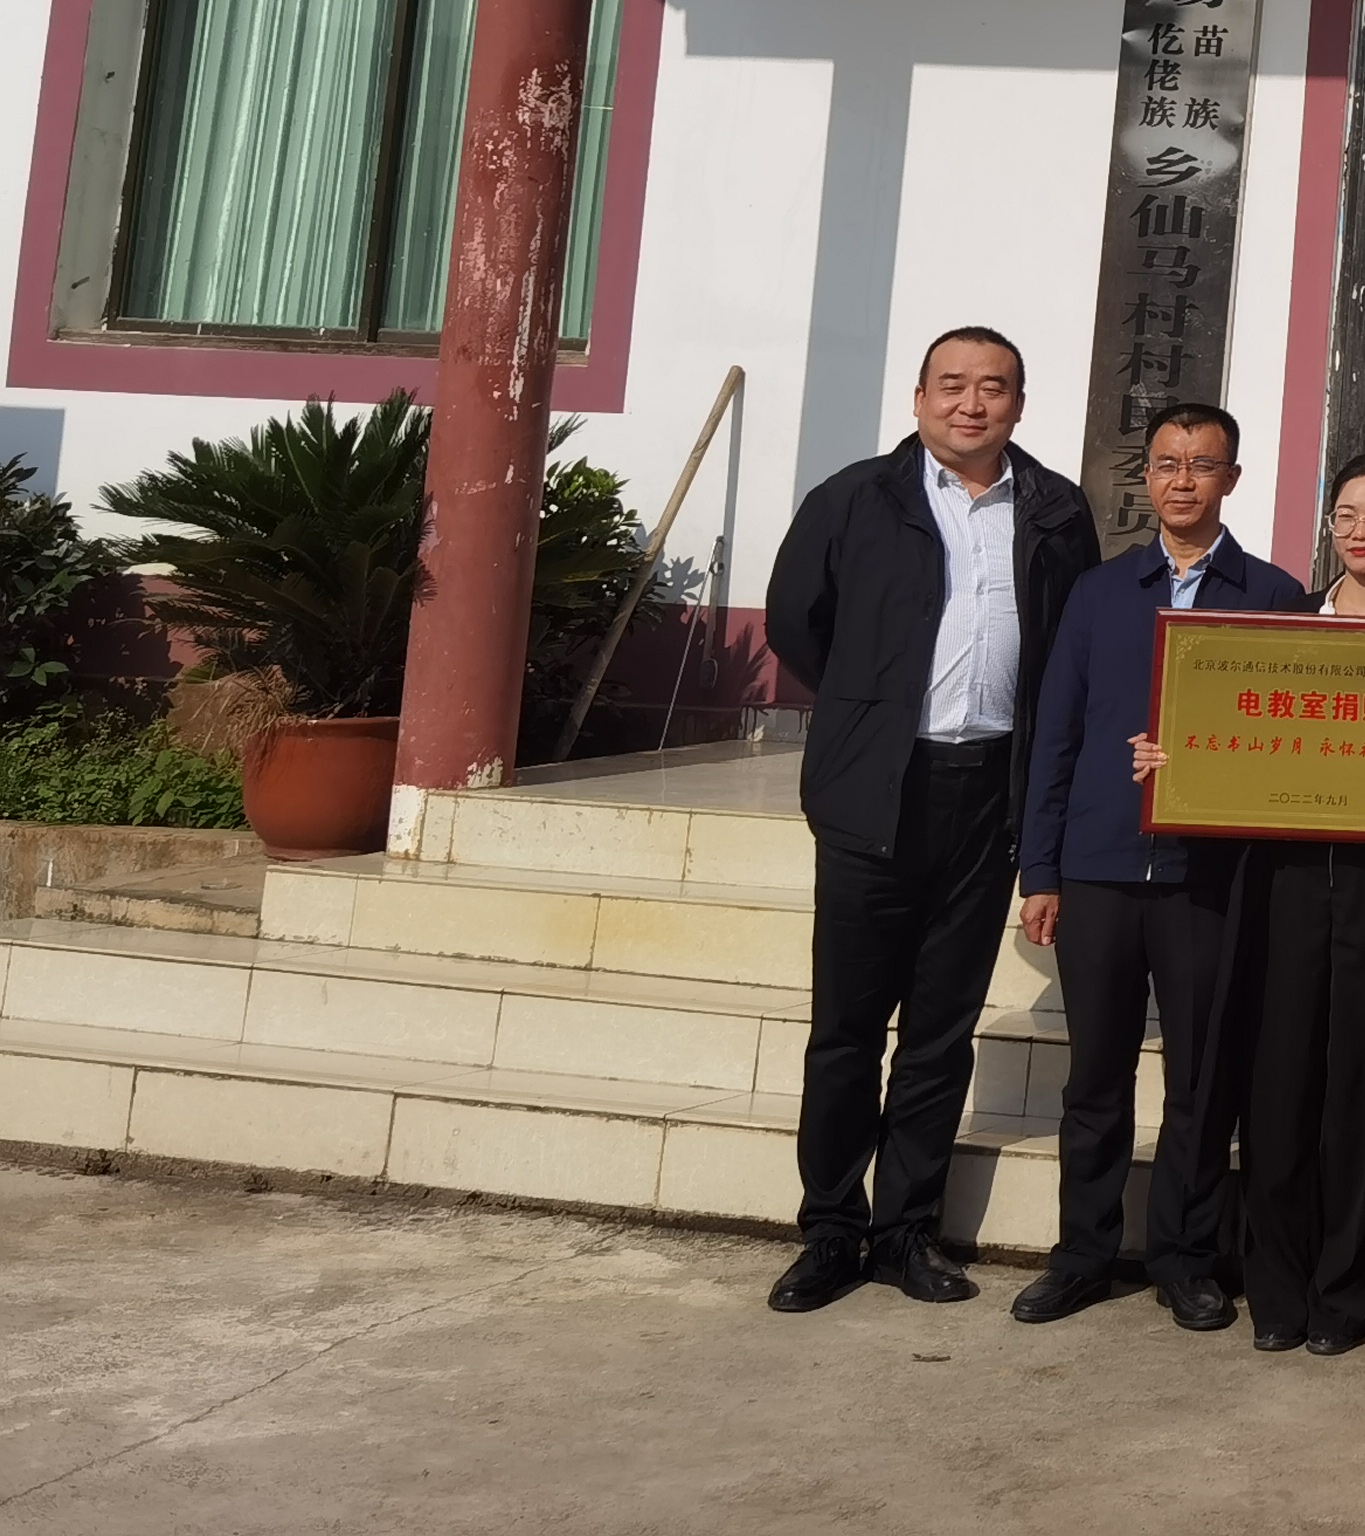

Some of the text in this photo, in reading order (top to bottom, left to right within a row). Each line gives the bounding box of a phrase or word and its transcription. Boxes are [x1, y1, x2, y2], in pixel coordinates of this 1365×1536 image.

[1184, 735, 1303, 756] 不忘书山岁月
